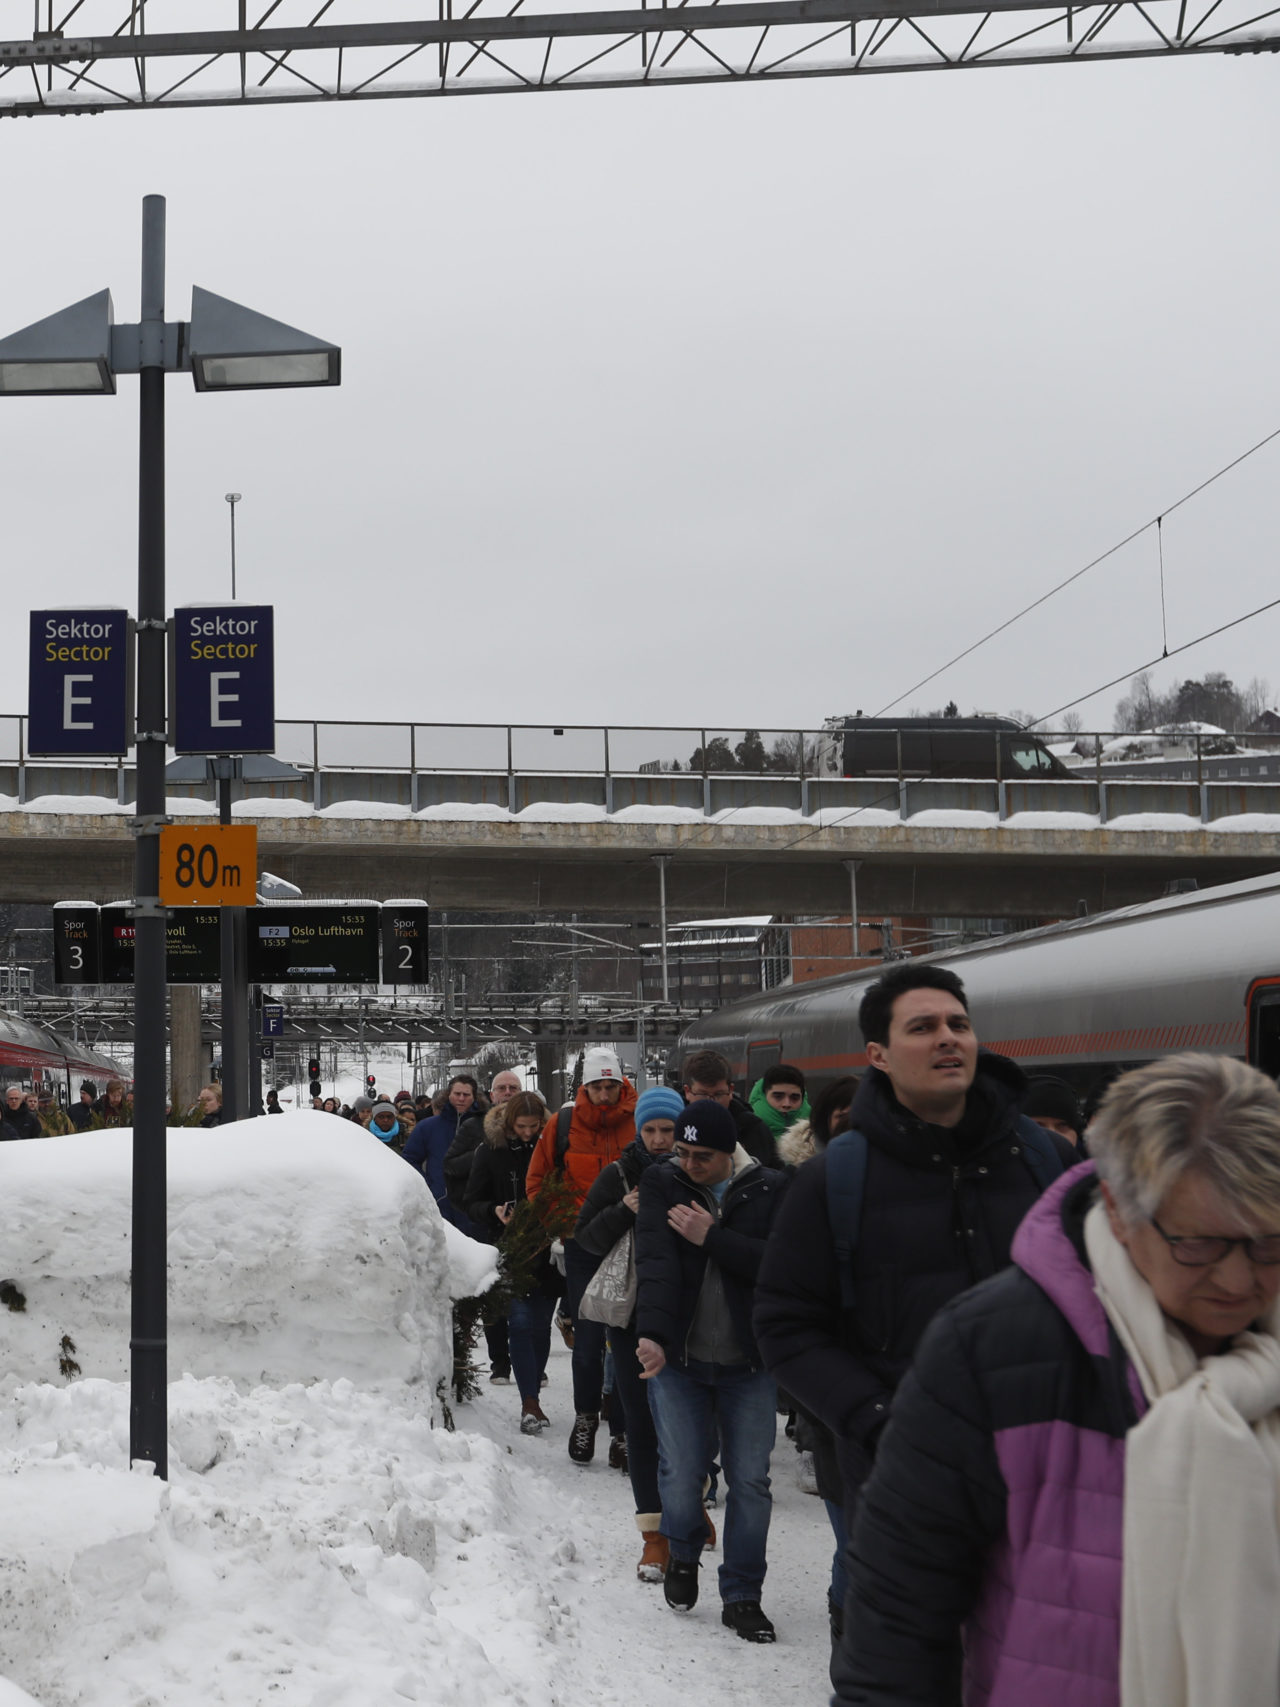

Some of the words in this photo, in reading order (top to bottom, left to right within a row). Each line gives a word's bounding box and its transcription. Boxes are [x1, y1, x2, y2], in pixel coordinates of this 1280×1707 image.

[44, 618, 113, 639] Sektor
[189, 615, 259, 637] Sektor
[45, 642, 112, 662] Sector
[190, 640, 258, 660] Sector
[63, 674, 94, 730] E
[210, 671, 242, 728] E
[64, 919, 85, 930] Spor
[194, 916, 218, 924] 15:33
[341, 915, 366, 923] 15:33
[393, 918, 415, 928] Spor
[64, 929, 89, 939] Track
[291, 926, 315, 936] Oslo
[318, 926, 364, 936] Lufthavn
[394, 928, 418, 937] Track
[118, 939, 136, 947] 15:5
[263, 939, 287, 947] 15:35
[69, 945, 84, 970] 3
[398, 945, 413, 969] 2
[270, 1019, 277, 1032] F
[263, 1047, 271, 1056] G
